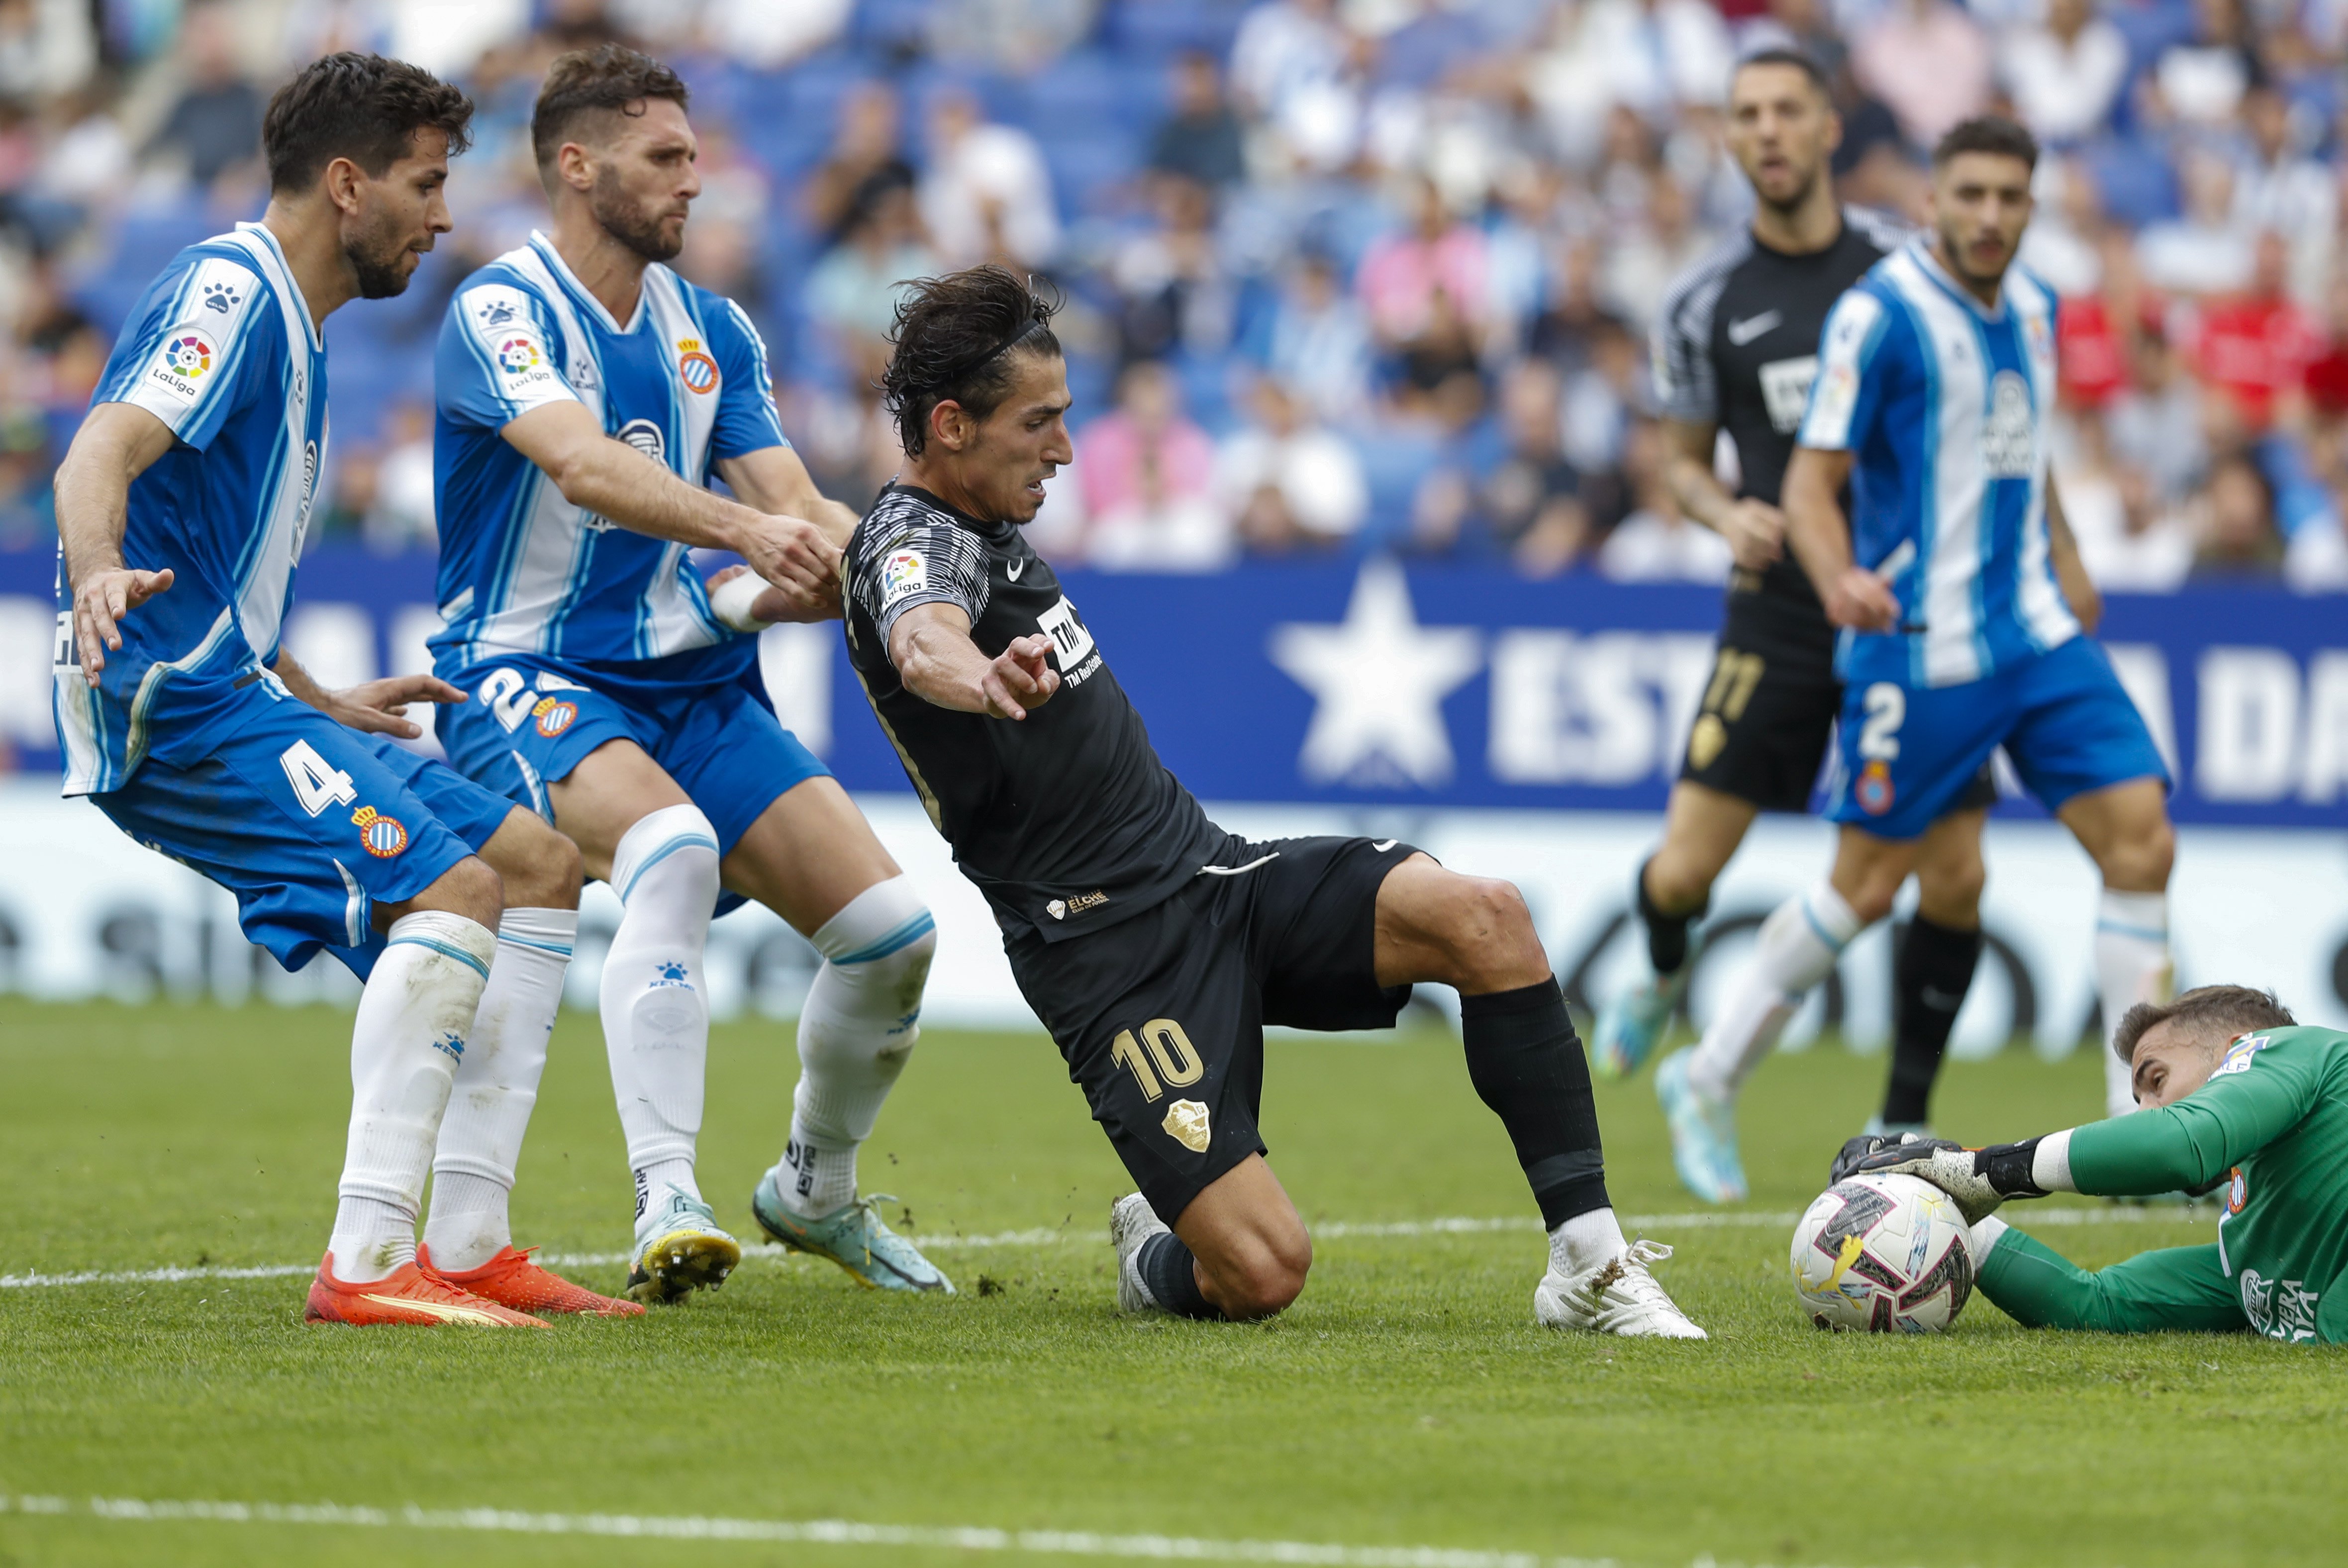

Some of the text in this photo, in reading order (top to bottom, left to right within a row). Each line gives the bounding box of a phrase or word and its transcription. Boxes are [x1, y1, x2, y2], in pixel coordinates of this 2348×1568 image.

[153, 369, 196, 396] LaLiga
[509, 372, 551, 391] LaLiga
[885, 582, 921, 605] LaLiga
[1051, 618, 1079, 654] TM
[1064, 671, 1081, 688] TM
[1858, 682, 1906, 762] 2
[279, 738, 358, 818] 4
[1068, 891, 1106, 910] ELCHE
[1110, 1018, 1204, 1104] 10
